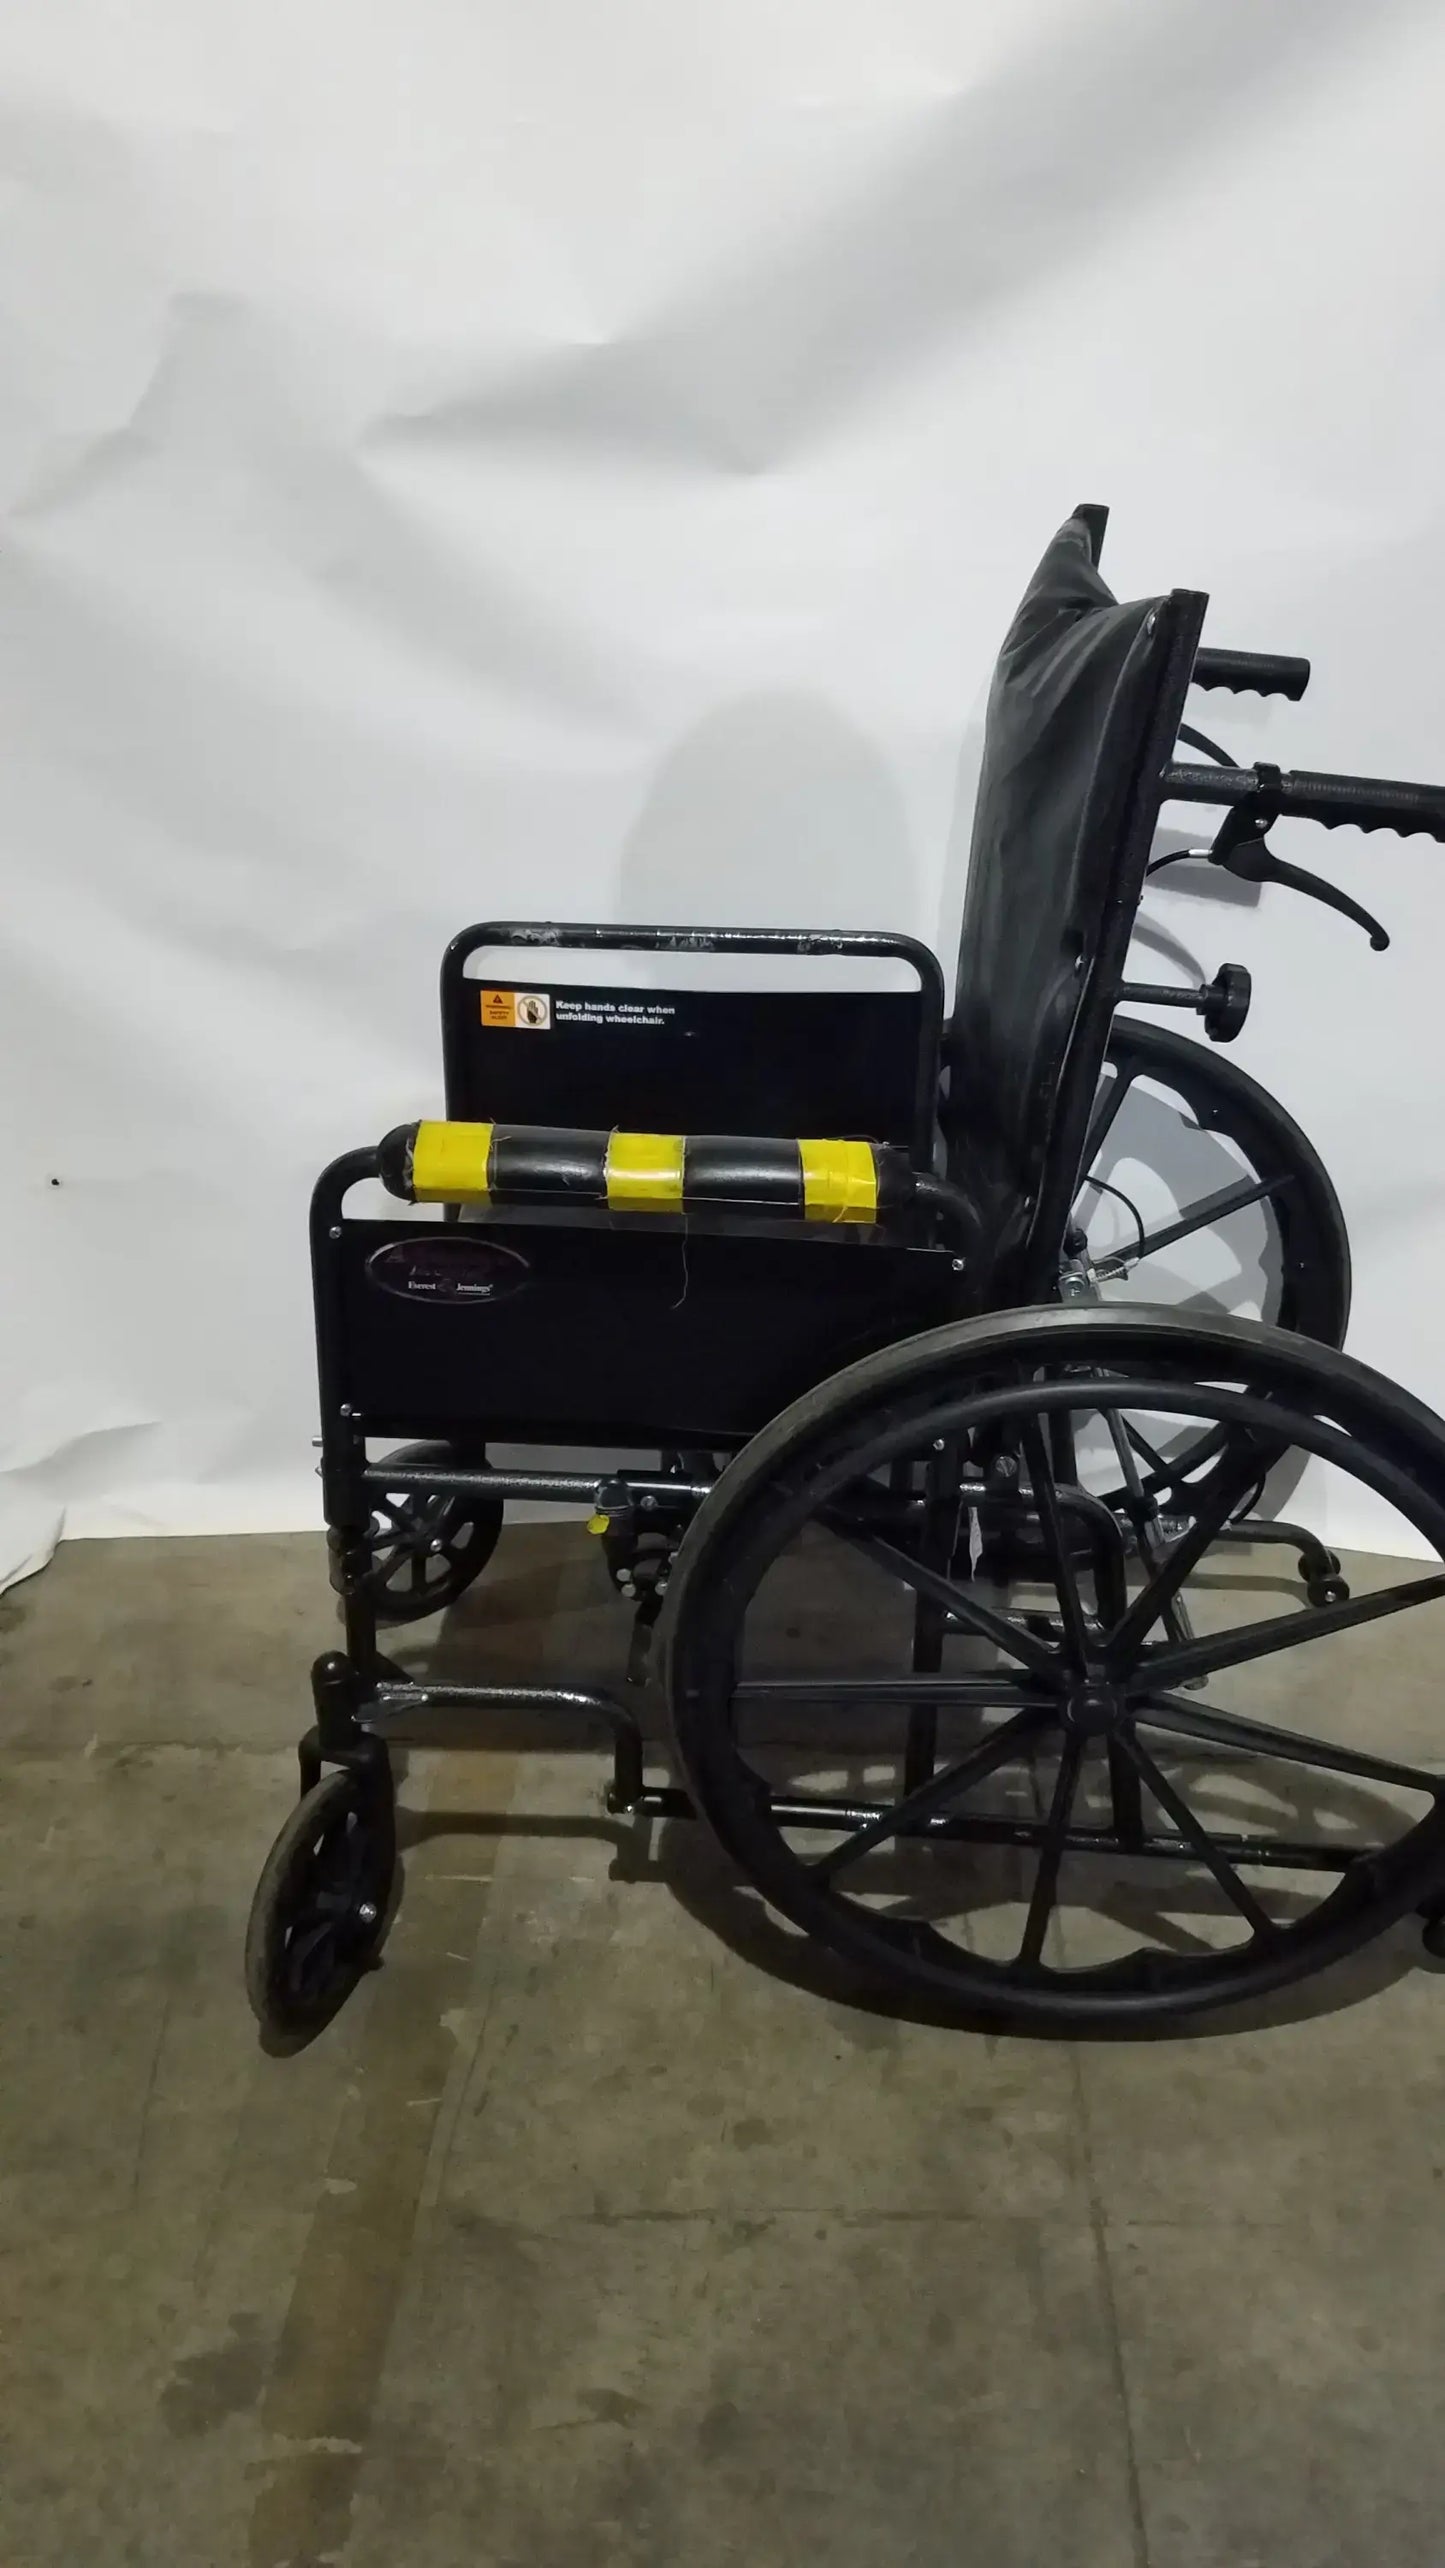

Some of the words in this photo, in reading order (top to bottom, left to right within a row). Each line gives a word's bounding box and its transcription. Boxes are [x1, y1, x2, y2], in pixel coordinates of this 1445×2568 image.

[555, 1000, 582, 1011] Keep
[584, 1002, 615, 1012] hands
[618, 1004, 644, 1013] clear
[647, 1006, 675, 1014] when
[555, 1012, 603, 1023] unfolding
[605, 1014, 665, 1024] wheelchair.
